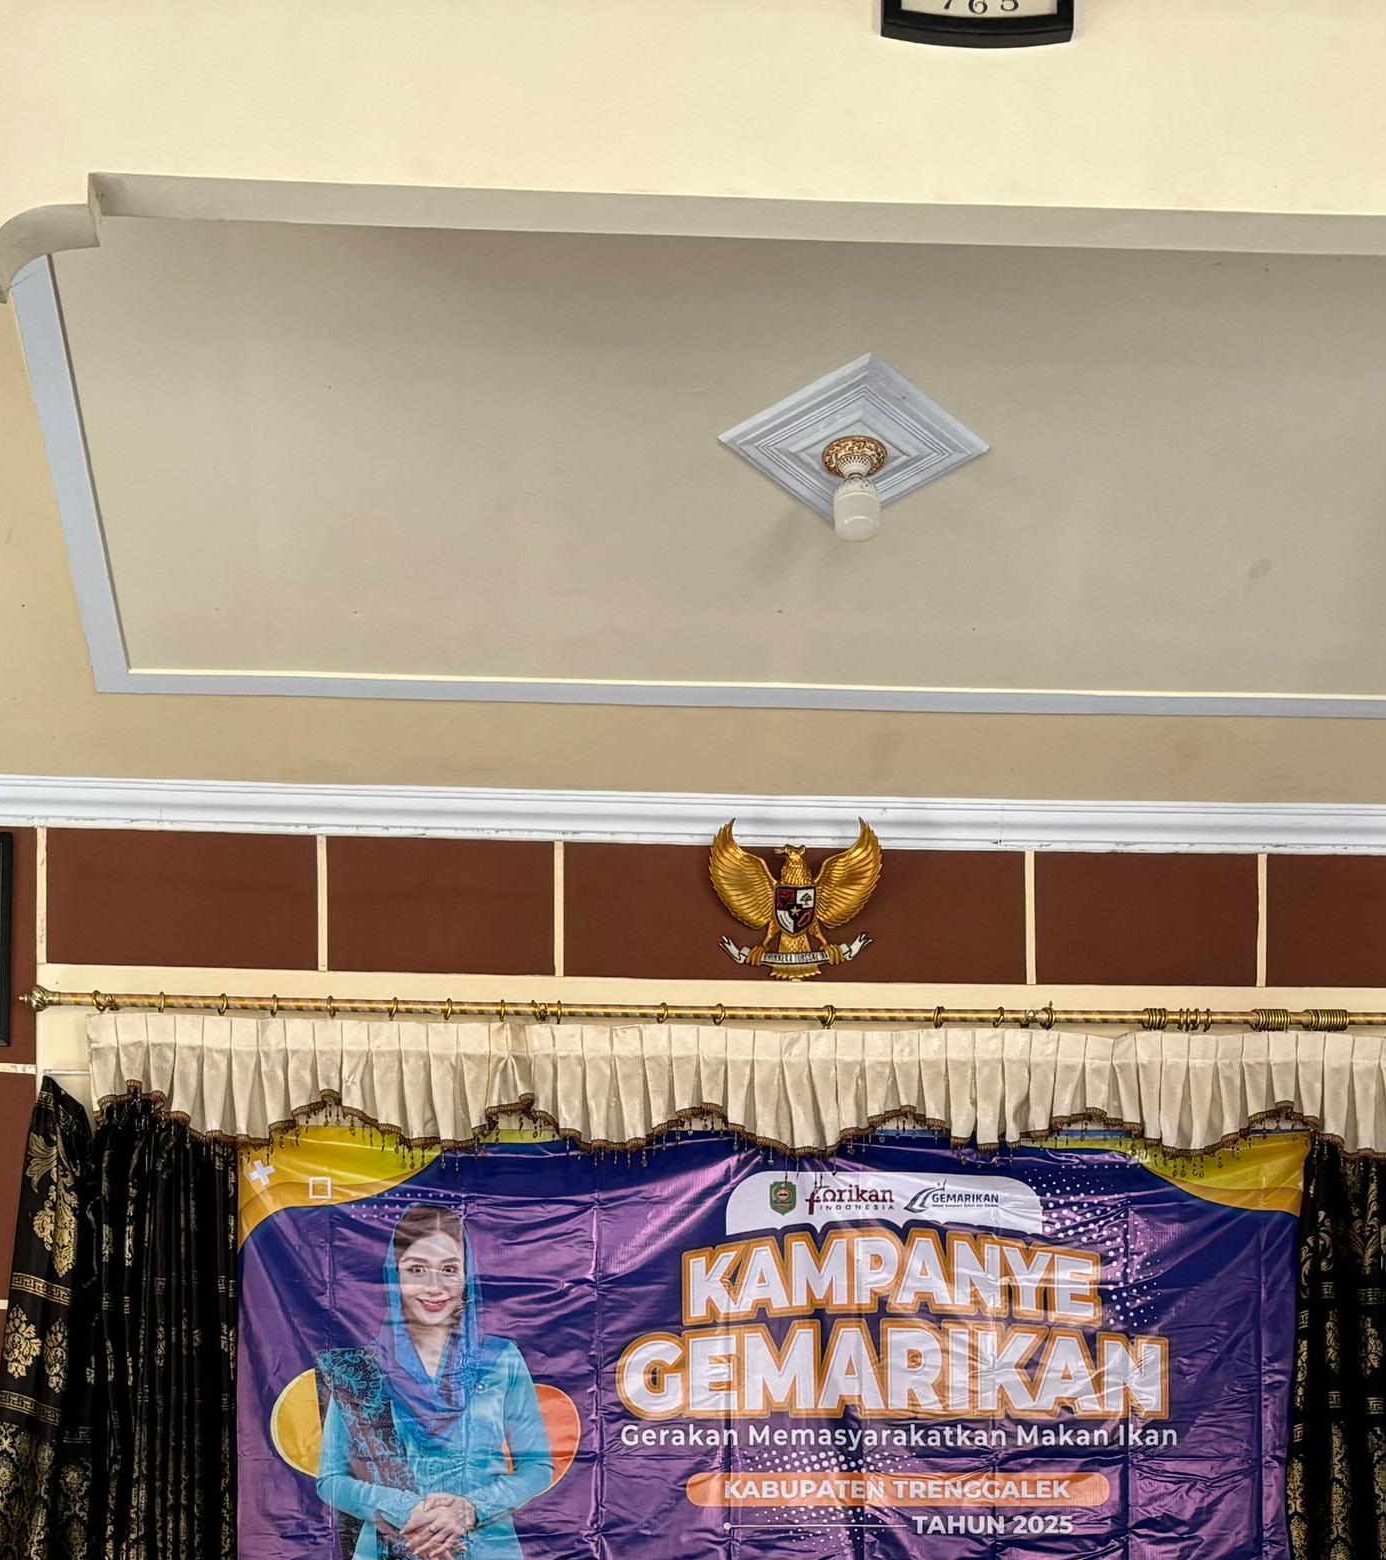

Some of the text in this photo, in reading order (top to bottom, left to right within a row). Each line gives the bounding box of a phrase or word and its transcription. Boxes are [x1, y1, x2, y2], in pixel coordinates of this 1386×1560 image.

[932, 1193, 999, 1203] GEMARIKAN
[687, 1235, 1096, 1320] KAMPANYE
[622, 1326, 1163, 1414] GEMARIKAN
[620, 1424, 1179, 1450] Gerakan Memasyarakatkan Makan Ikan
[724, 1479, 1072, 1500] KABUPATEN TRENGGALEK
[911, 1514, 1074, 1535] TAHUN 2025
